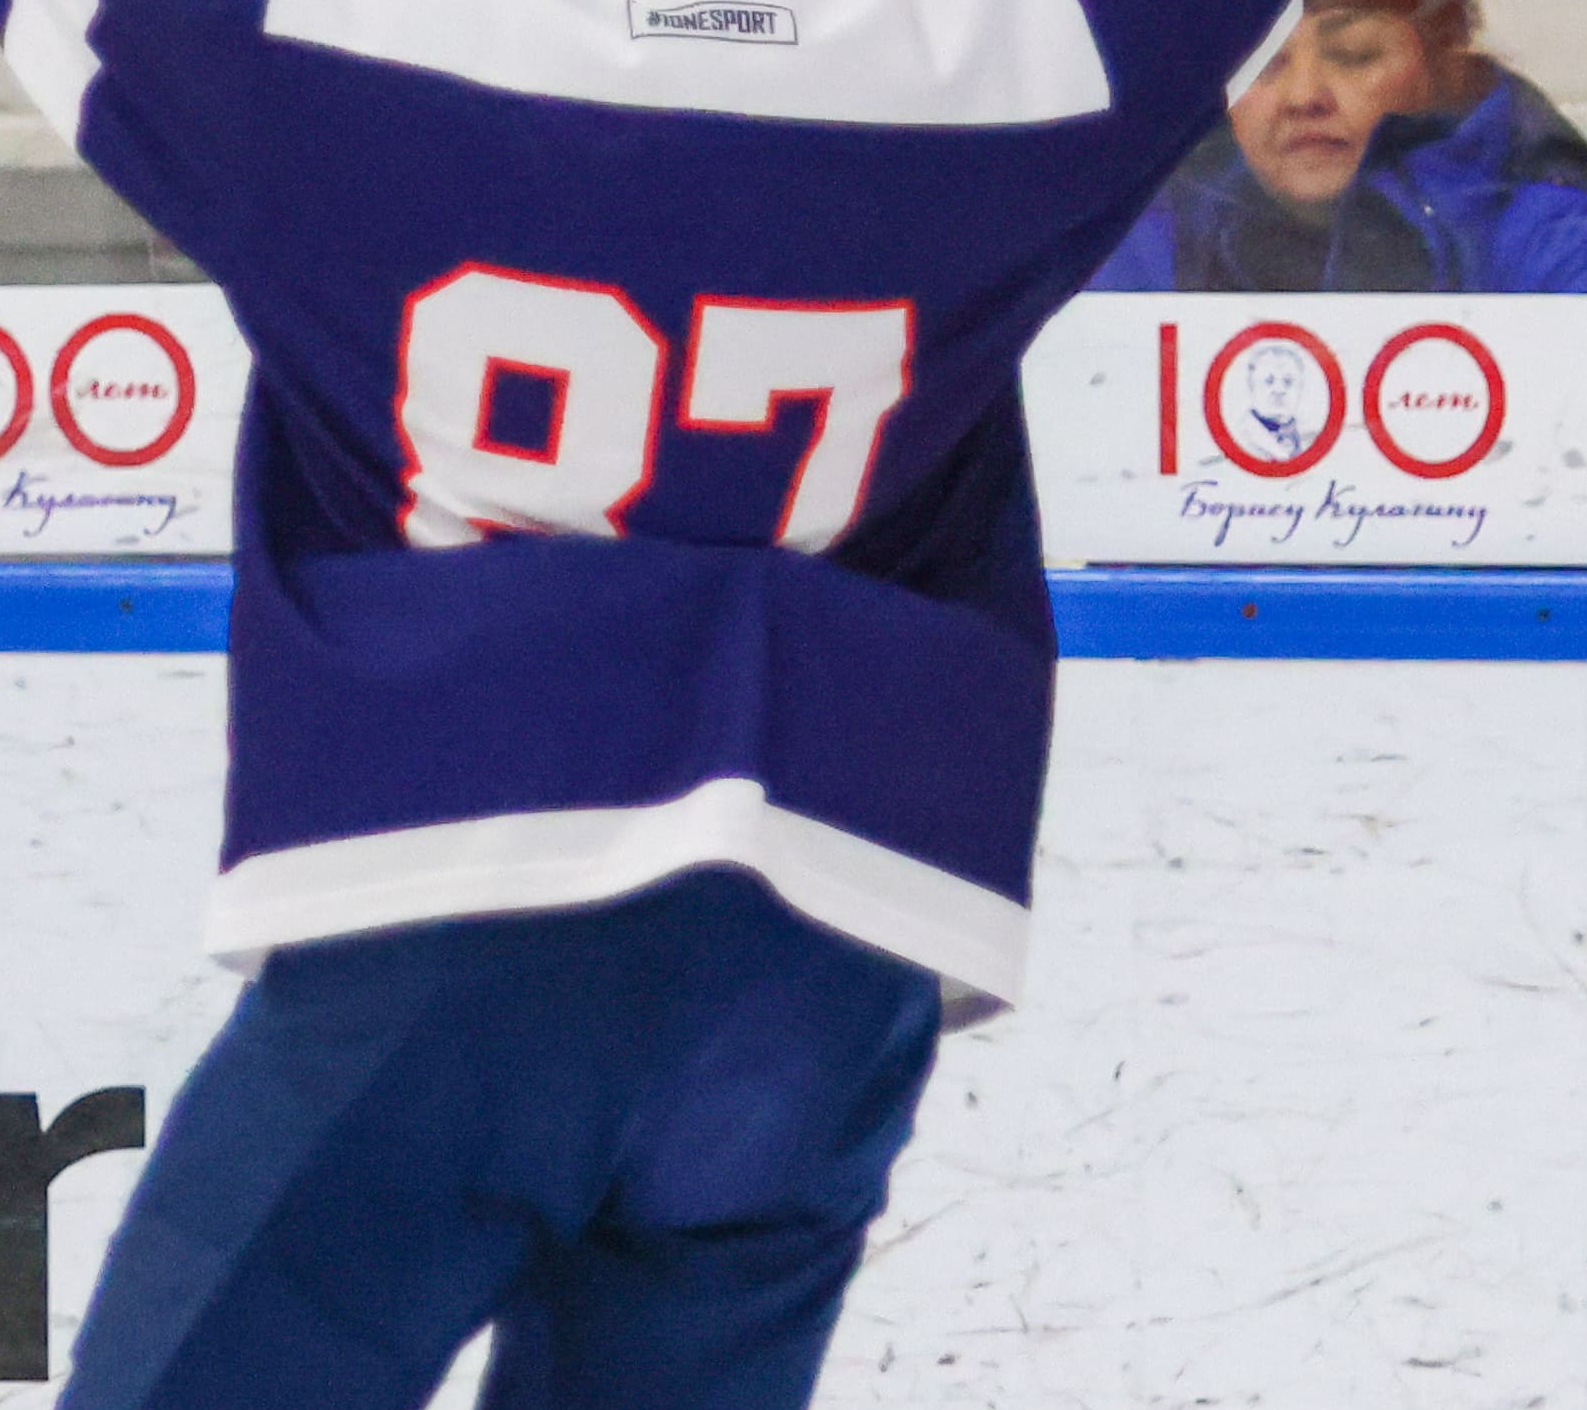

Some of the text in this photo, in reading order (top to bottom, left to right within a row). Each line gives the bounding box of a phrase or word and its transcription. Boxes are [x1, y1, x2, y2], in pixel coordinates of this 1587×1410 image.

[394, 260, 914, 553] 87
[1159, 319, 1507, 479] 100
[1180, 480, 1307, 547] Борису
